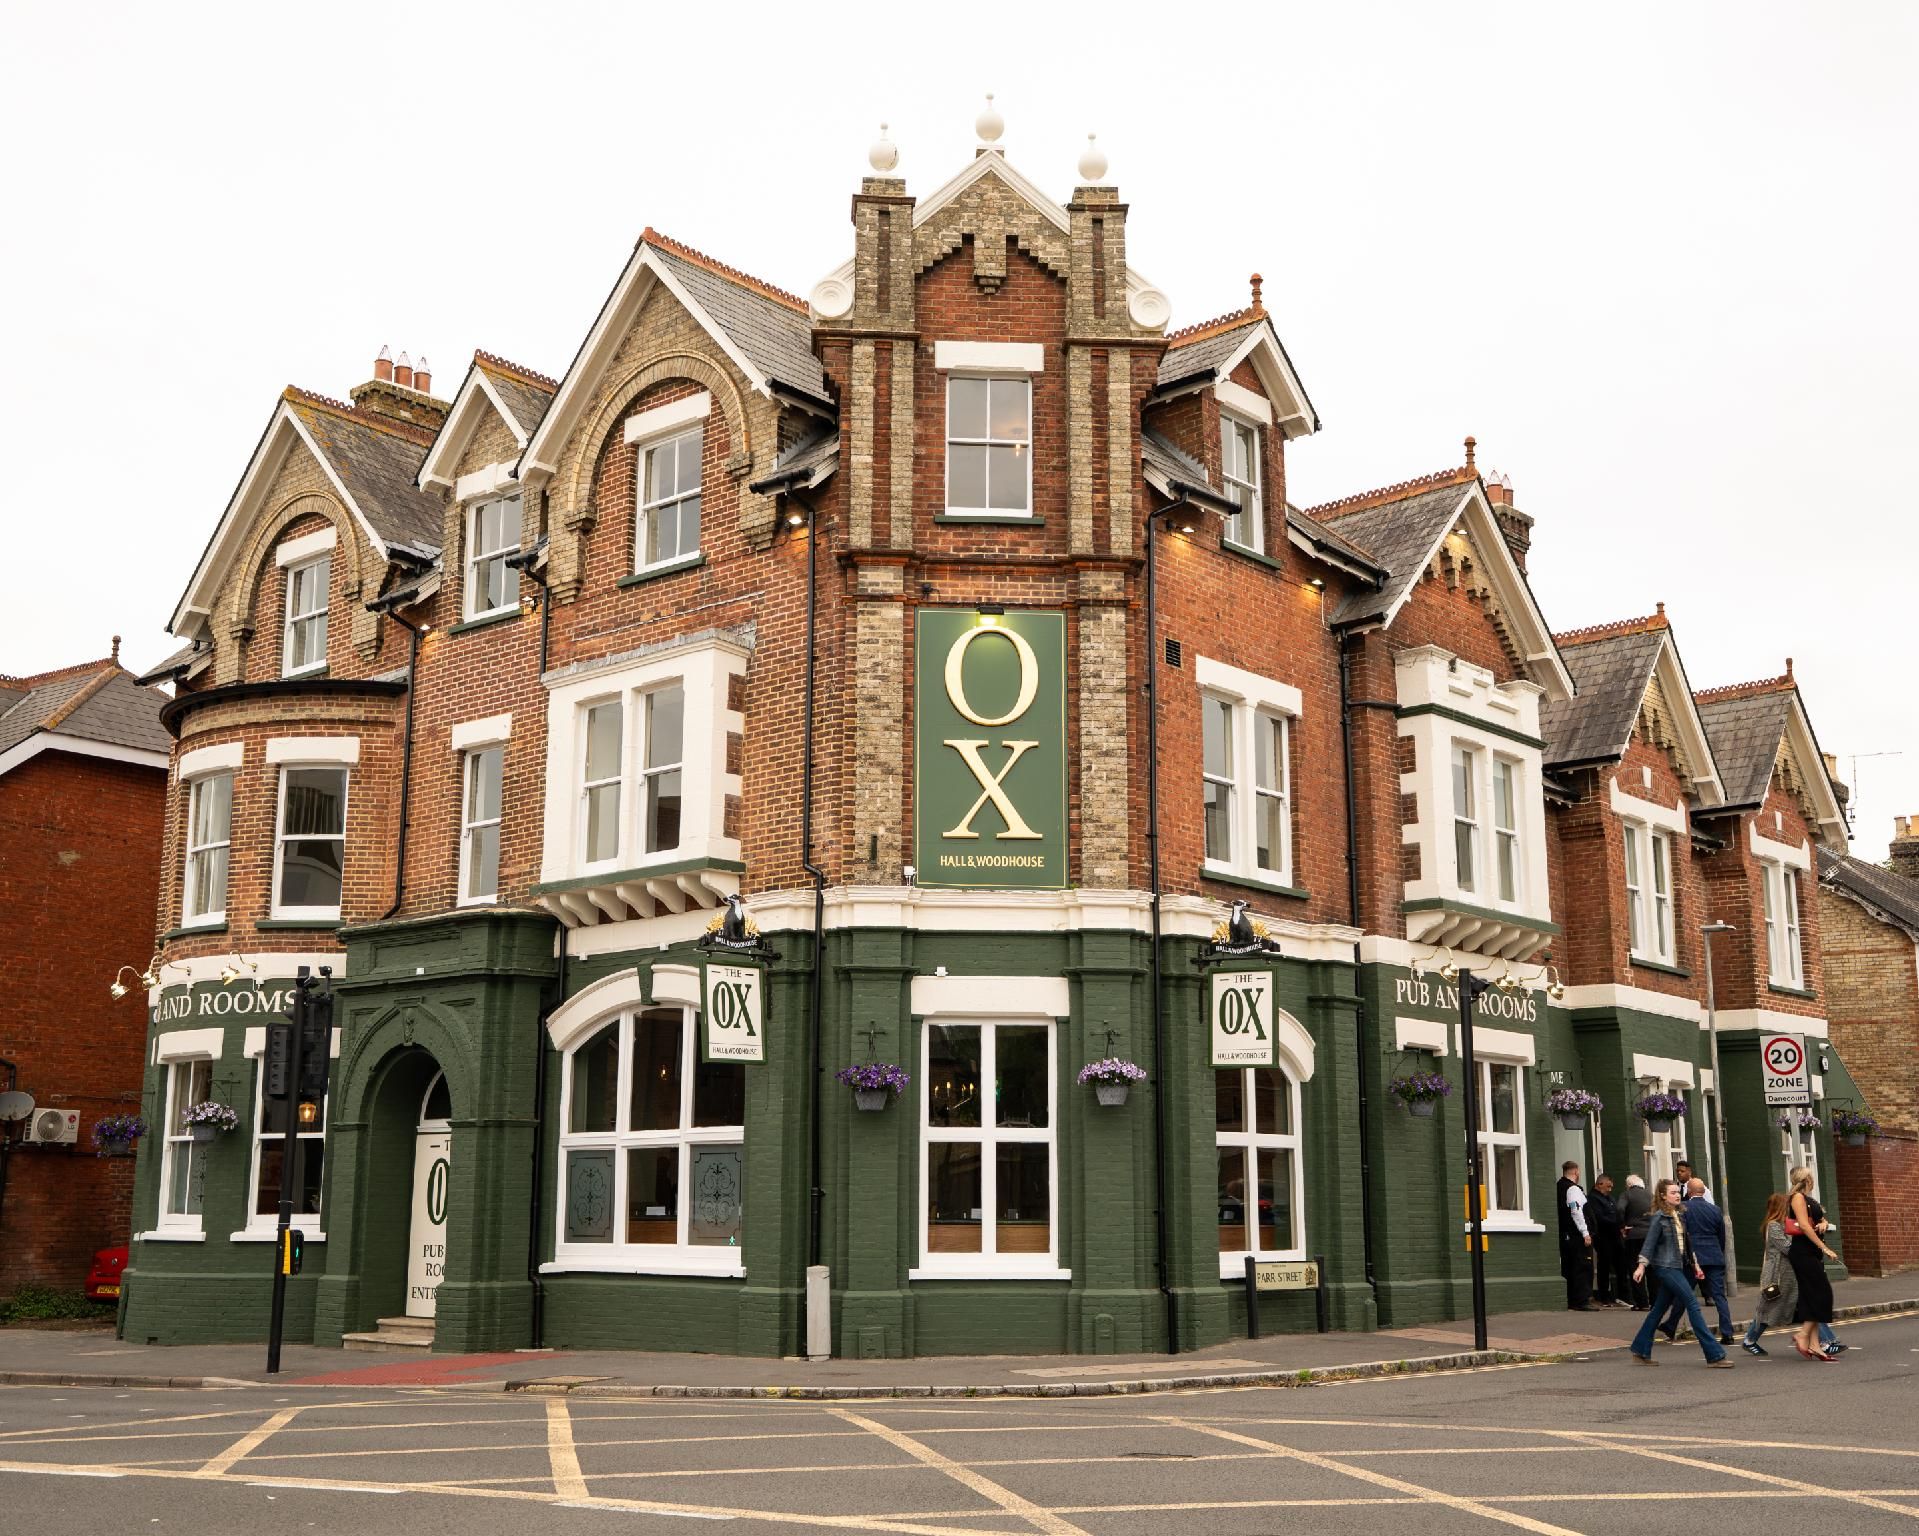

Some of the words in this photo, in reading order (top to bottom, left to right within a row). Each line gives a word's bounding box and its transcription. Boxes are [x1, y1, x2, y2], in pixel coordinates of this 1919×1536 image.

[724, 968, 742, 978] THE
[1233, 974, 1253, 984] THE
[161, 995, 192, 1021] AND
[1395, 979, 1430, 1006] PUB
[1435, 985, 1460, 1011] AN
[1478, 991, 1537, 1022] ROOMS
[712, 981, 757, 1037] OX
[1219, 988, 1267, 1041] OX
[1770, 1048, 1797, 1065] 20
[1768, 1077, 1803, 1088] ZONE
[427, 1157, 450, 1226] O
[423, 1244, 444, 1258] PUB
[425, 1262, 446, 1277] RO
[1257, 1272, 1276, 1284] PARR
[1277, 1271, 1303, 1282] STREET
[411, 1286, 437, 1300] ENTR
